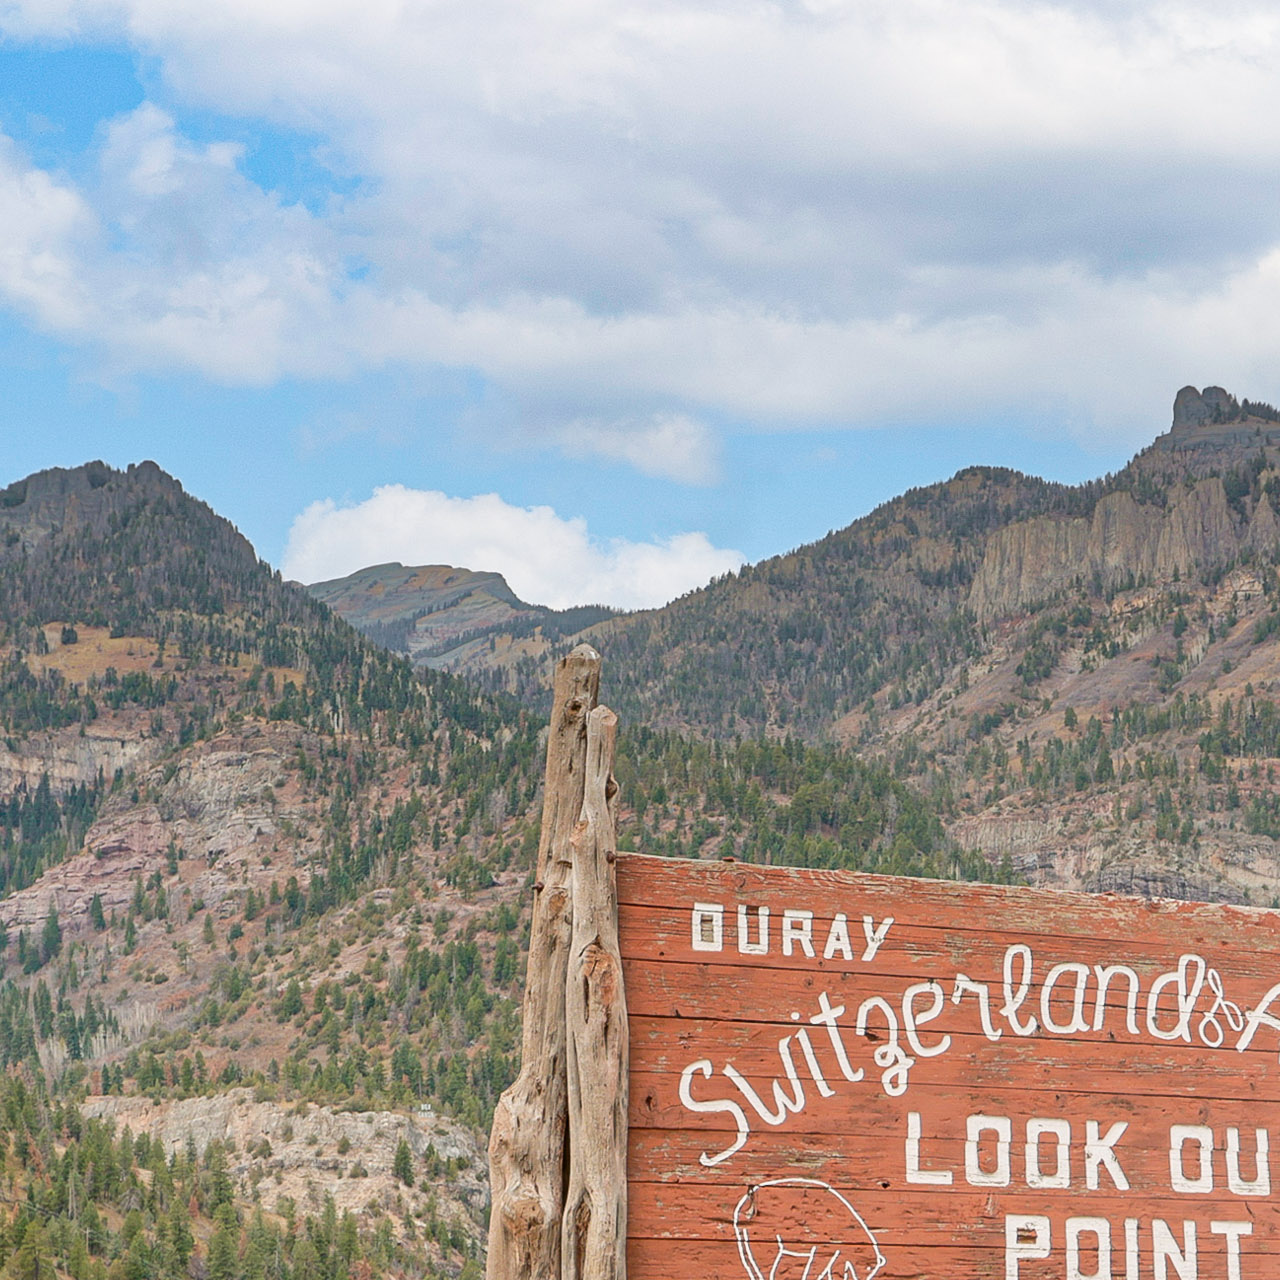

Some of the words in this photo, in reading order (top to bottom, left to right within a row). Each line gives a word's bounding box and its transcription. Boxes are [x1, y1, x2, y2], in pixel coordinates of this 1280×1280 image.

[690, 900, 896, 962] OURAY
[677, 942, 1208, 1168] Switzerland
[904, 1111, 1130, 1191] LOOK
